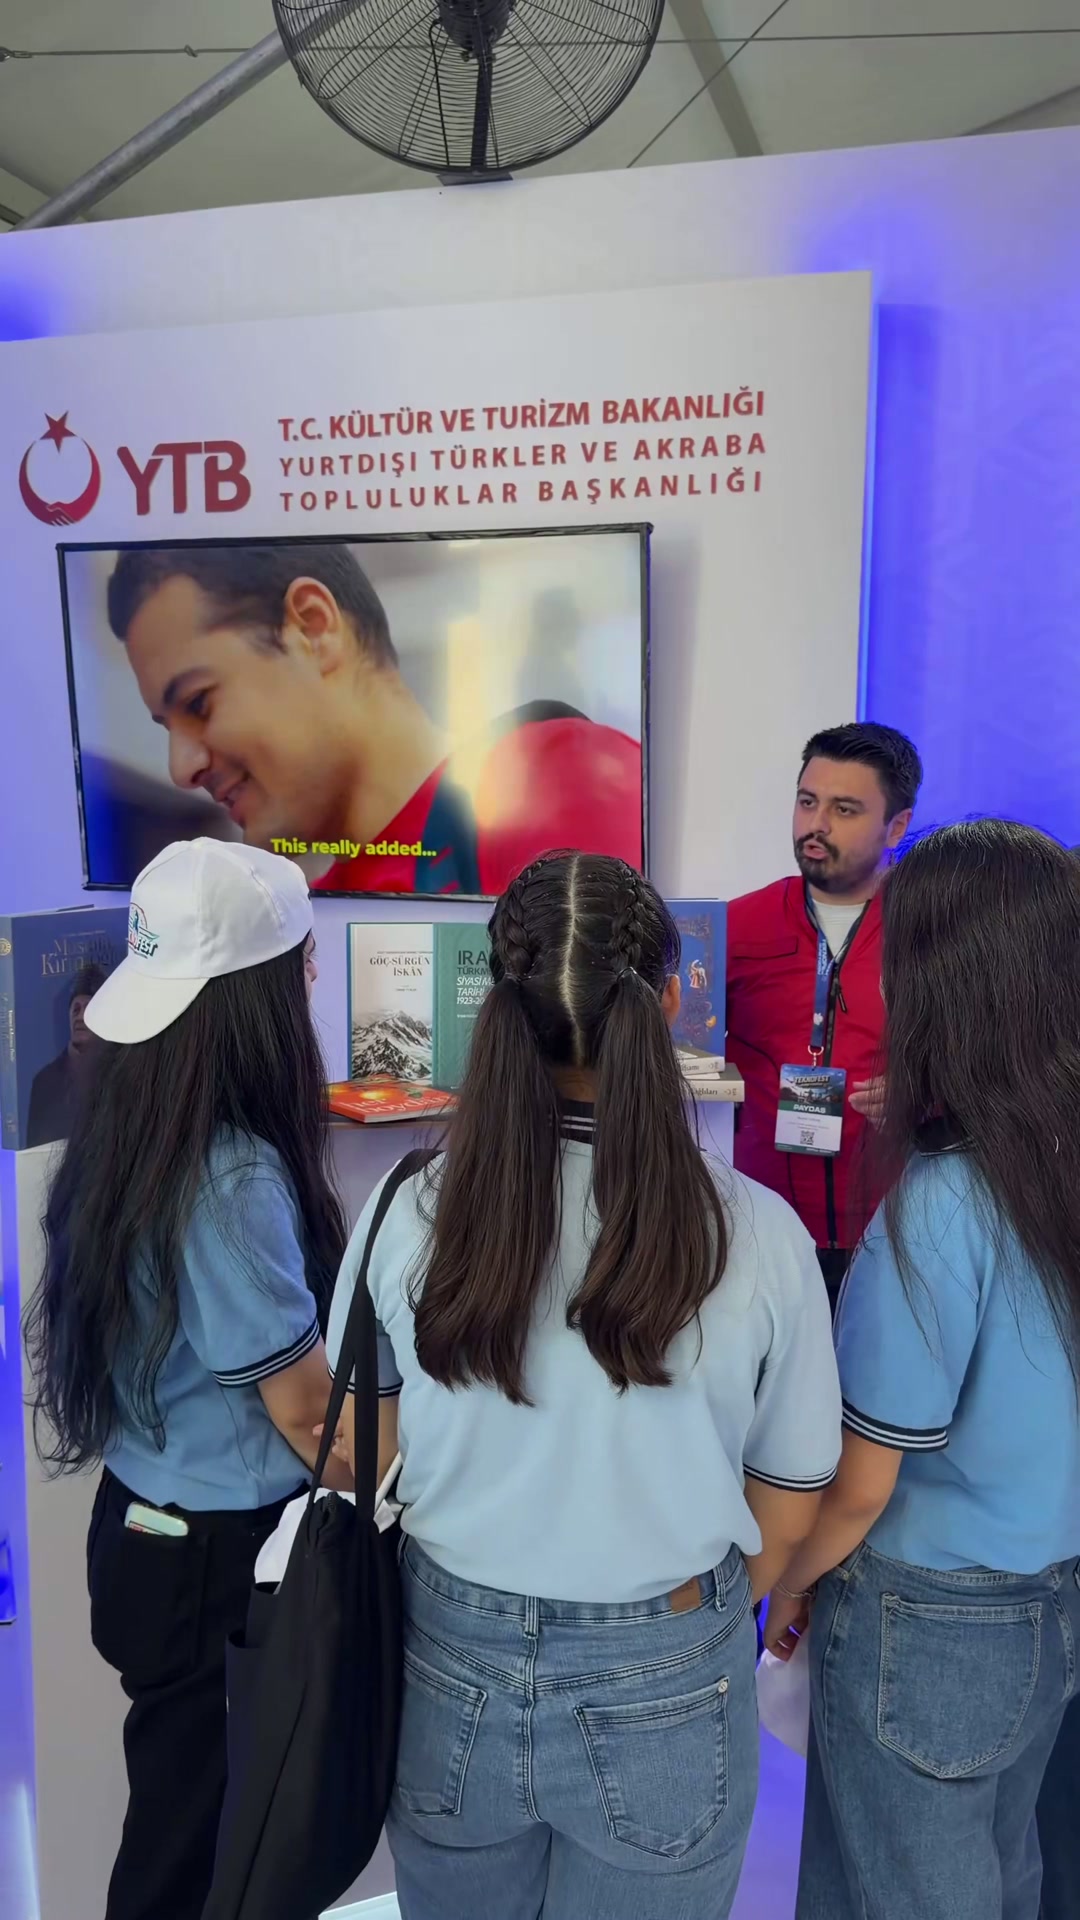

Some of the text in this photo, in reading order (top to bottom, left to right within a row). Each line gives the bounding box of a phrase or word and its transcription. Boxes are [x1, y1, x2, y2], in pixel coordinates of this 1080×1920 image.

[278, 386, 765, 442] T.C. KÜLTÜR VE TURİZM BAKANLIĞI
[279, 432, 767, 478] YURTDIŞI TÜRKLER VE AKRABA
[116, 440, 252, 516] YTB
[279, 466, 762, 513] TOPLULUKLAR BAŞKANLIĞI
[270, 837, 438, 859] This really added...
[457, 965, 490, 975] TÜRKM
[458, 950, 489, 966] IRA
[456, 996, 486, 1005] 1923-20
